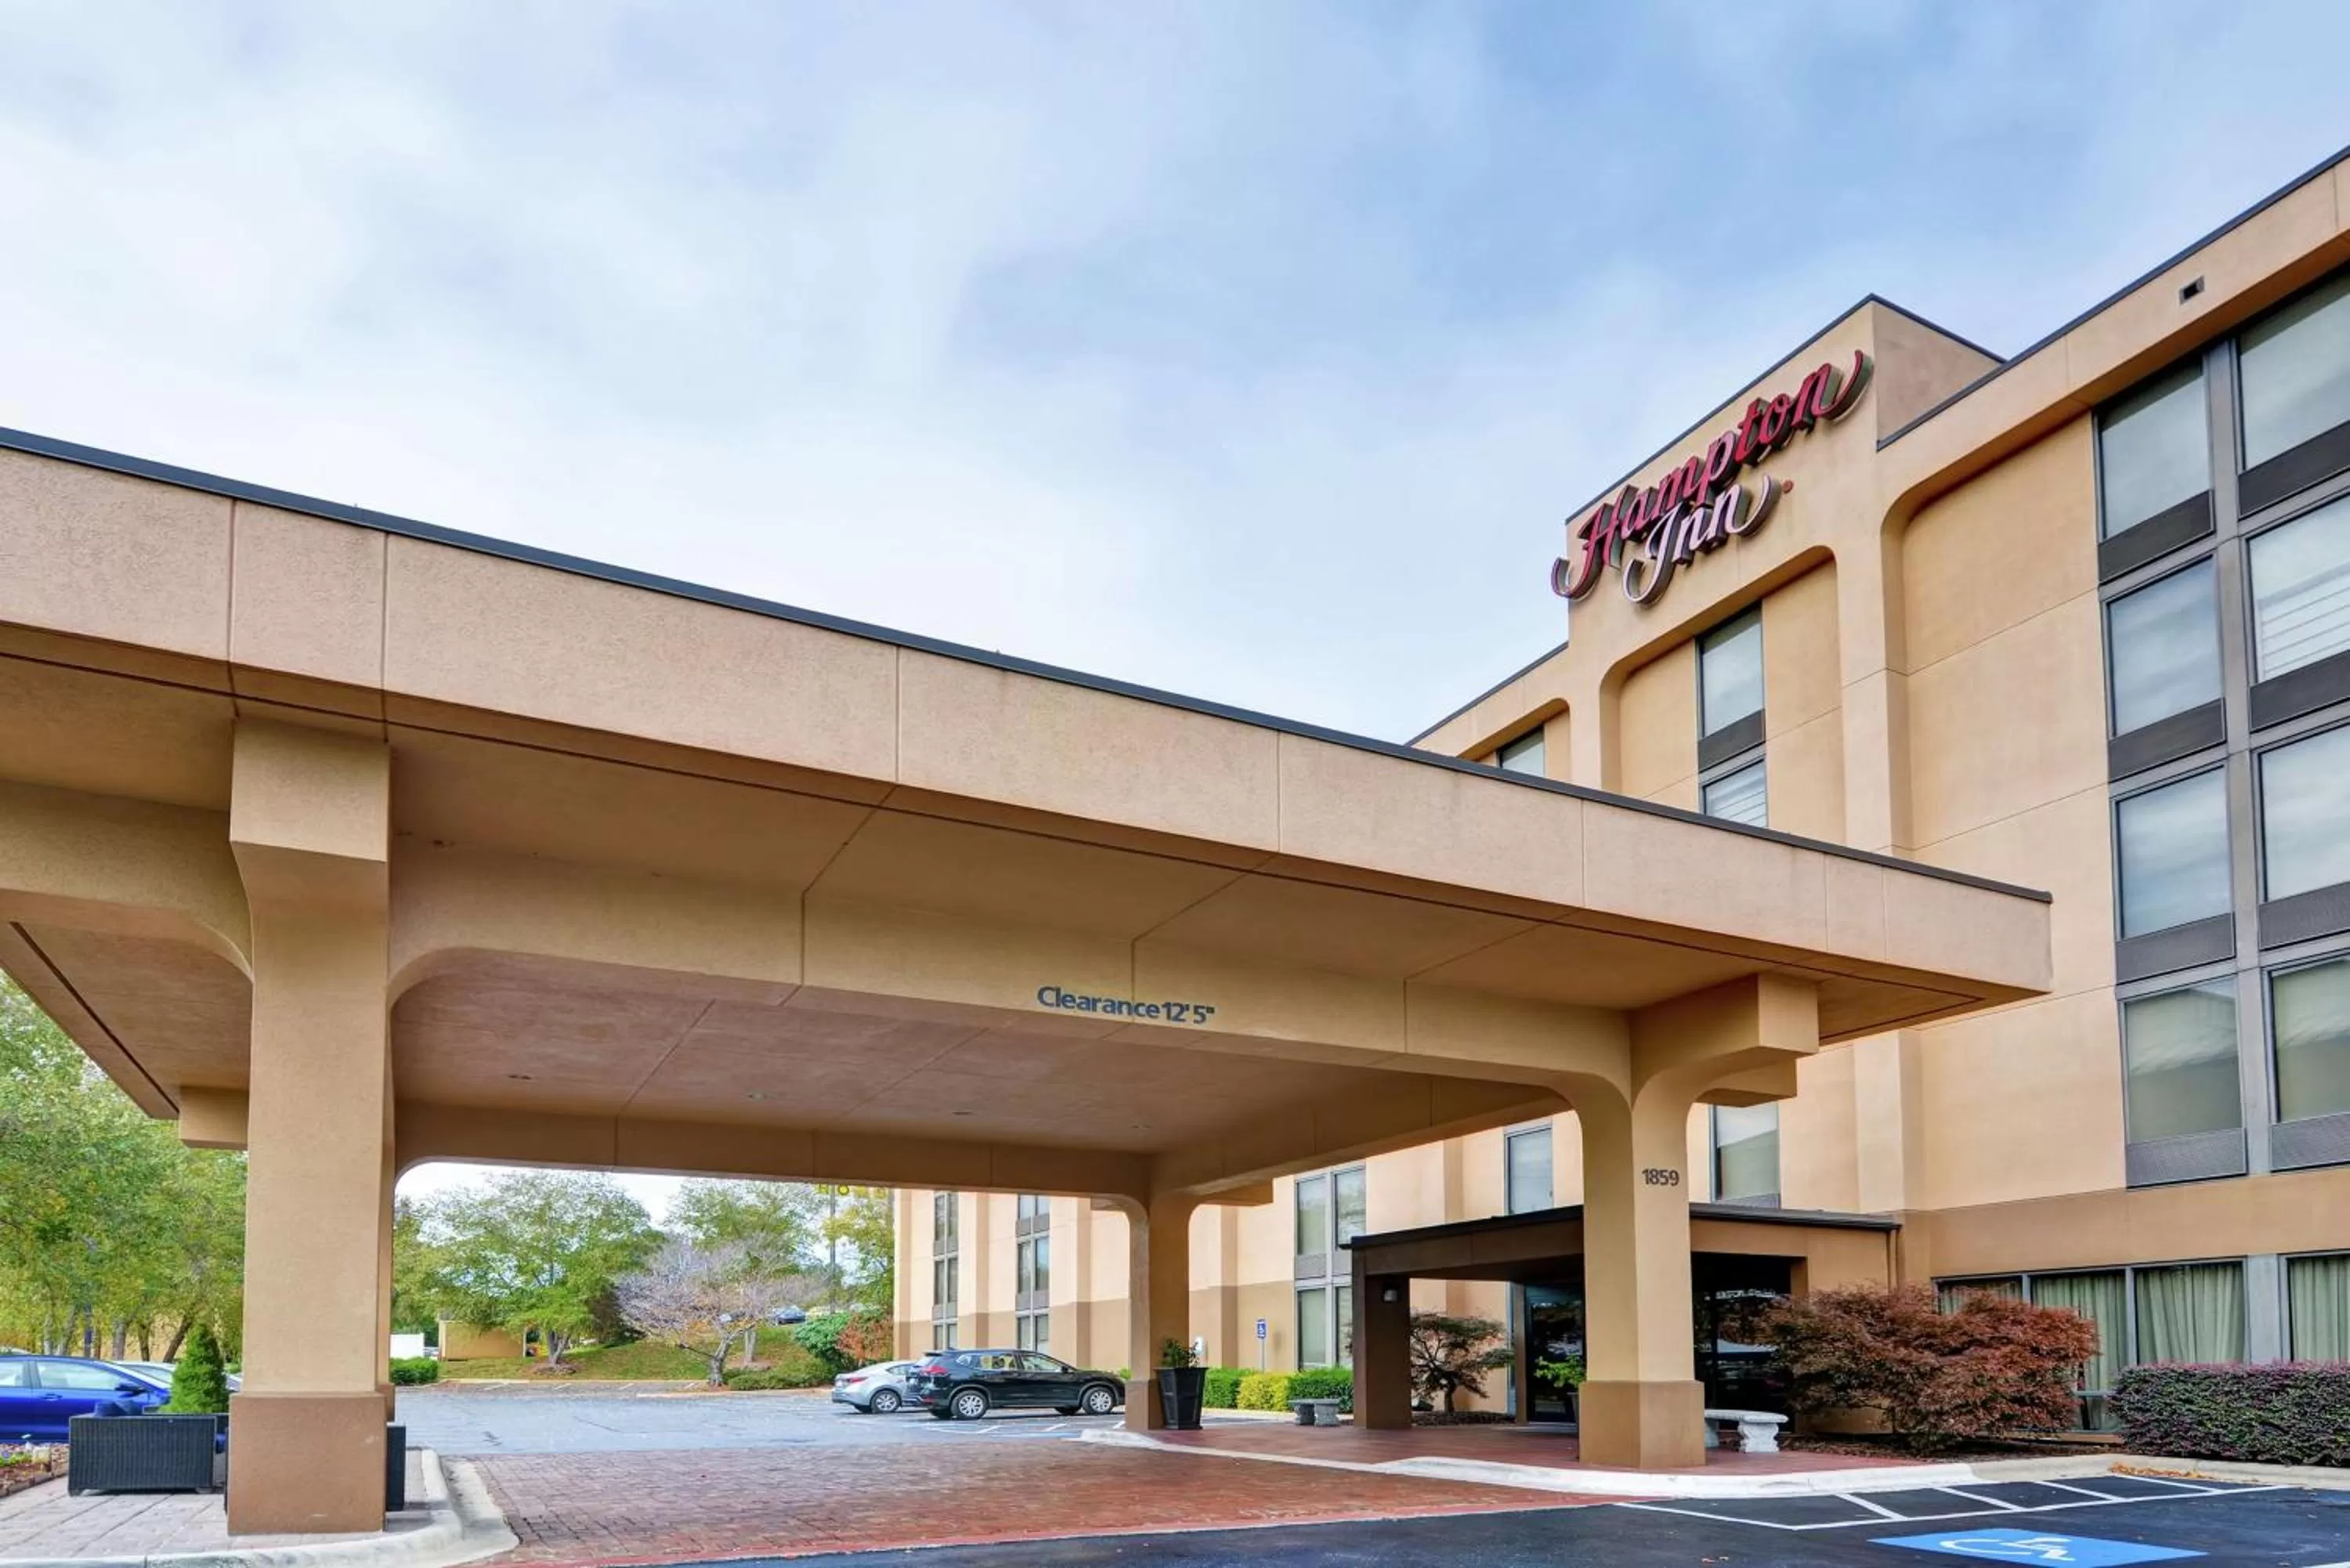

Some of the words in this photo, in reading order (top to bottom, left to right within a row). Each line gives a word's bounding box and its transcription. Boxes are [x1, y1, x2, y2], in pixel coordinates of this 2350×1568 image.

[1551, 349, 1873, 601] Hampton
[1622, 475, 1781, 605] Inn
[1037, 986, 1160, 1018] Clearance
[1641, 1168, 1679, 1187] 1859
